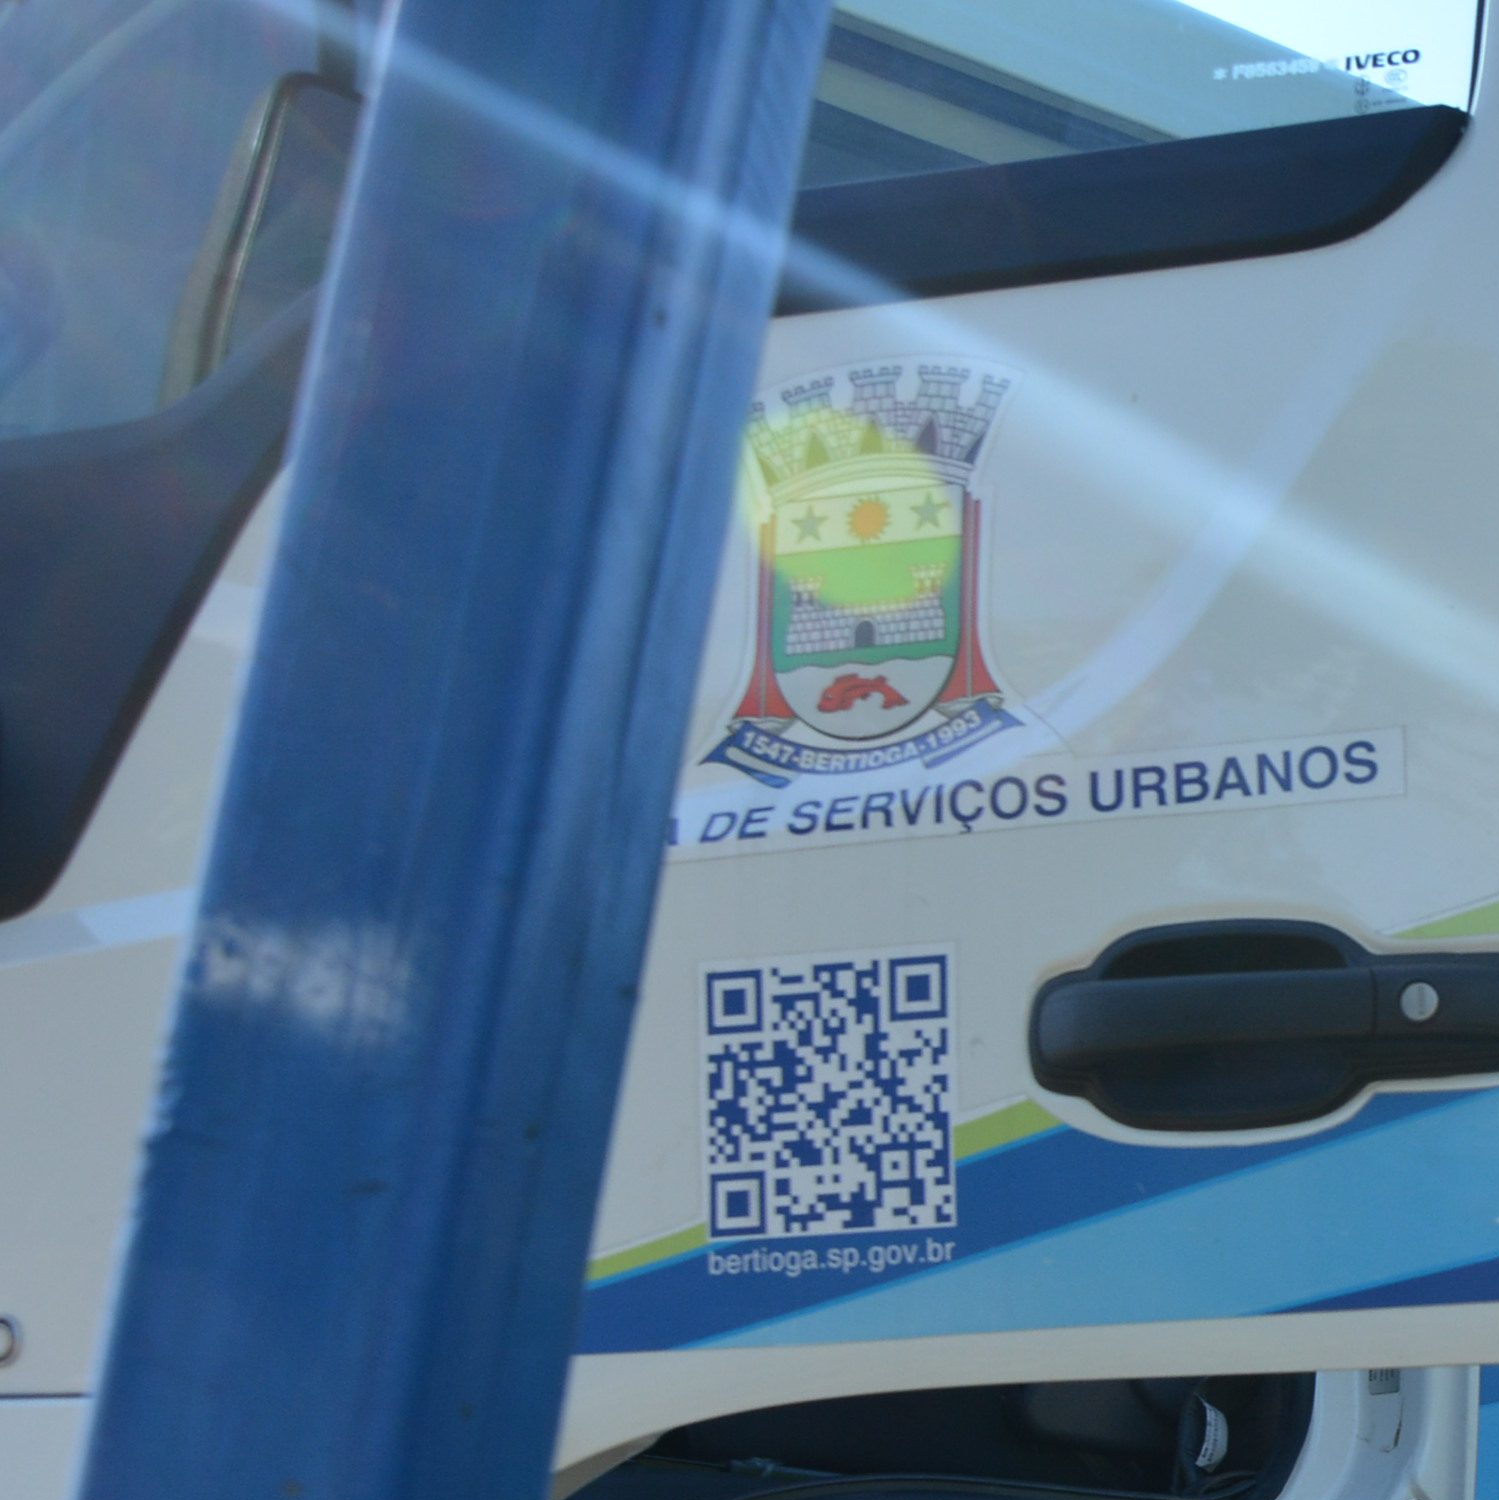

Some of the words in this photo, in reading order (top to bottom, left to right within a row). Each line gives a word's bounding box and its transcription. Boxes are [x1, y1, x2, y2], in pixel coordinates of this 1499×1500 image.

[1345, 49, 1421, 71] IVECO
[741, 711, 982, 771] 1547-BERTIOGA-1993
[700, 805, 776, 843] DE
[788, 773, 1068, 835] SERVIÇOS
[1089, 740, 1378, 812] URBANOS
[708, 1237, 956, 1277] bertioga.sp.gov.br
